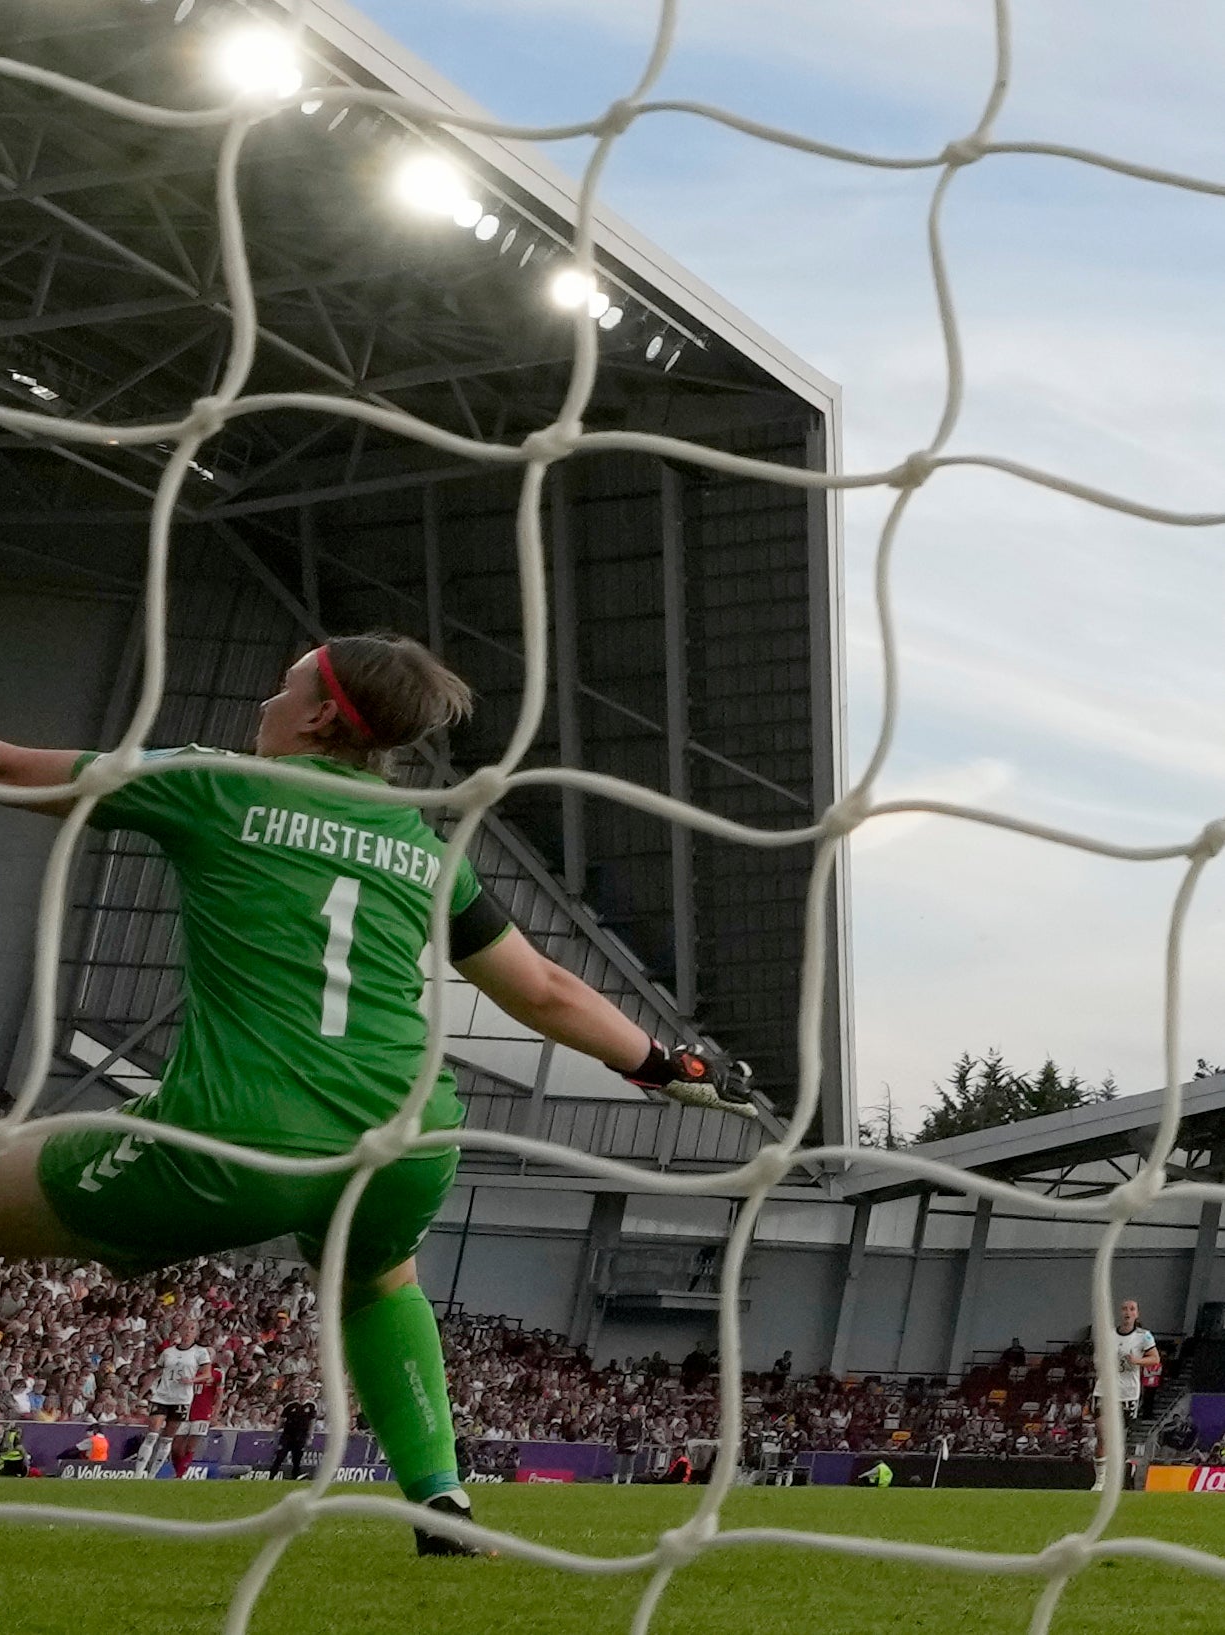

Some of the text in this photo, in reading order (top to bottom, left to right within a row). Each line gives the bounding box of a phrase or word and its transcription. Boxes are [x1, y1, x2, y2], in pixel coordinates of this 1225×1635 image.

[240, 805, 441, 889] CHRISTENSEN
[320, 875, 361, 1037] 1
[77, 1465, 149, 1480] Volkswagn
[332, 1467, 376, 1482] RIFOLS
